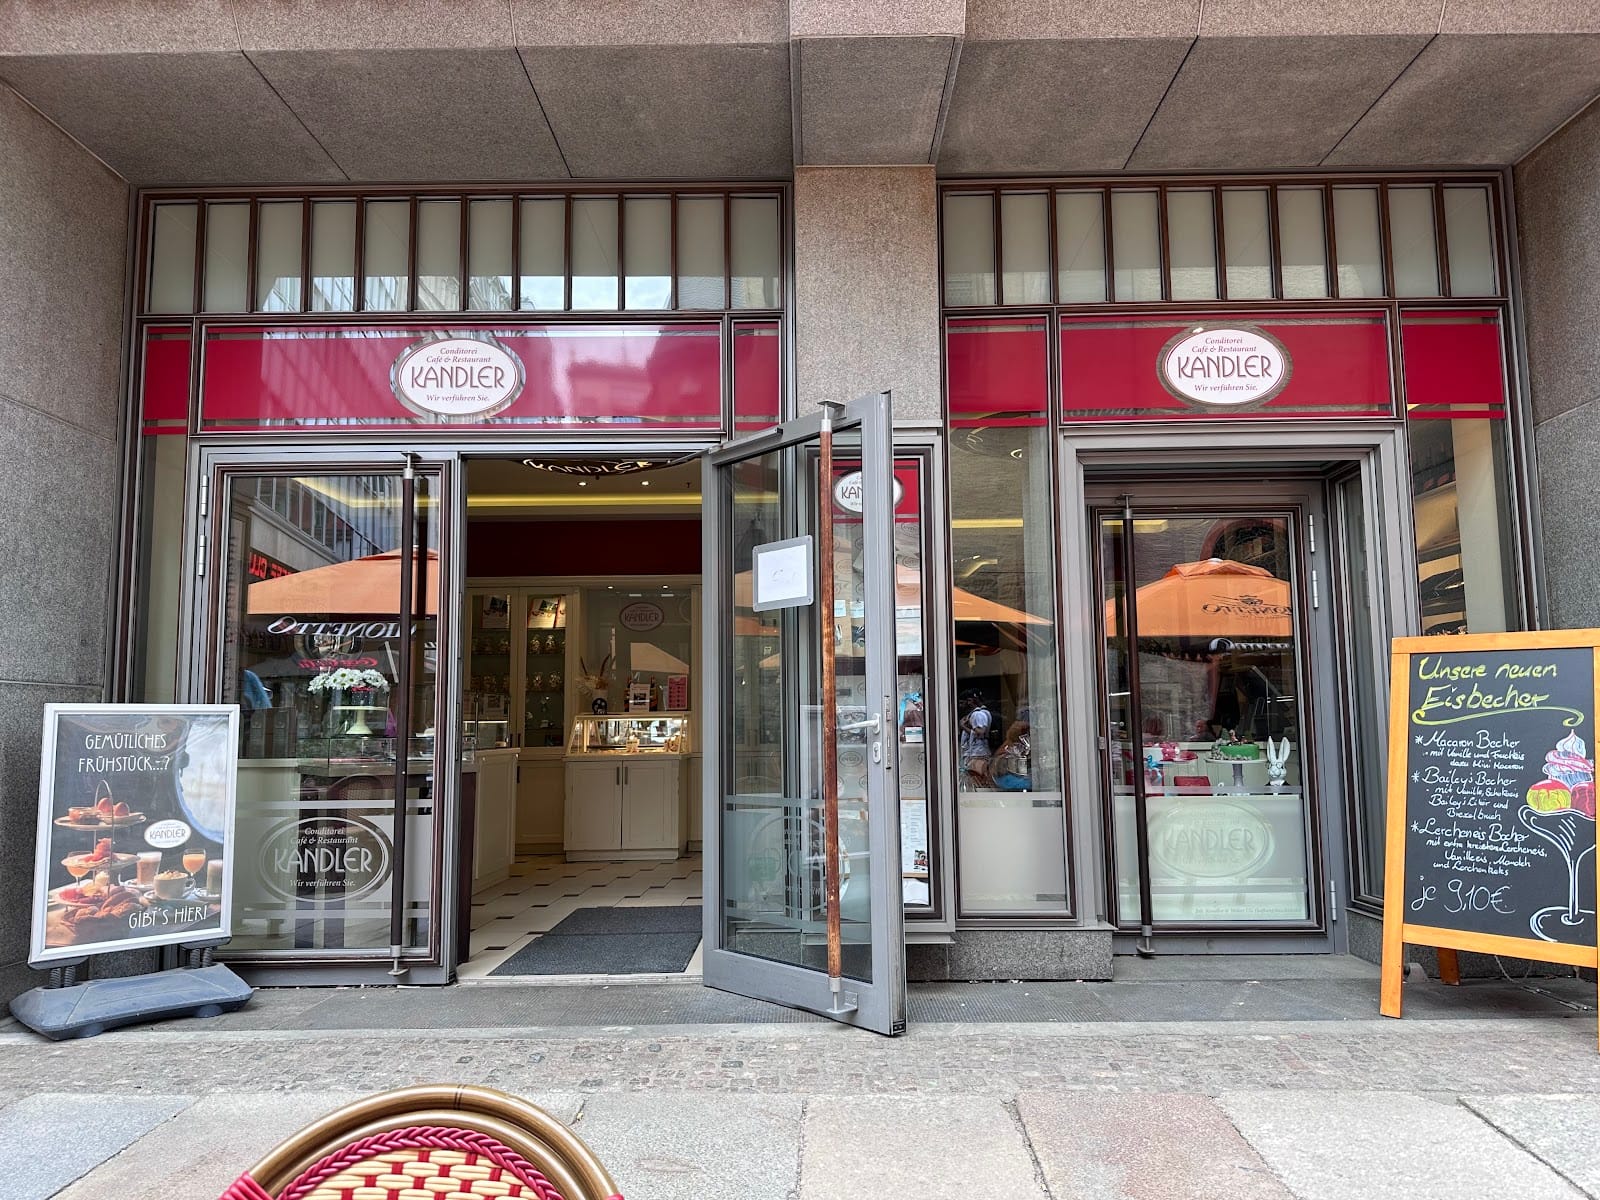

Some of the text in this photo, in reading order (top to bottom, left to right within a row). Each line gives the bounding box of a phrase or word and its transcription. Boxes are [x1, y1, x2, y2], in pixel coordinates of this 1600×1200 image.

[1205, 337, 1243, 345] Conditorei
[440, 347, 478, 355] Conditorei
[1191, 345, 1209, 354] Café
[1218, 345, 1257, 353] Restaurant
[426, 355, 443, 363] Café
[452, 355, 492, 363] Restaurant
[1177, 355, 1273, 379] KANDLER
[411, 365, 505, 389] KANDLER
[1194, 384, 1208, 392] Wir
[1210, 384, 1244, 392] verführen
[426, 394, 440, 402] Wir
[441, 394, 476, 403] verführen
[1418, 656, 1557, 680] Unsere neuen
[1420, 683, 1550, 710] Eisbecher
[85, 733, 166, 749] GEMÜTLICHES
[1423, 729, 1520, 749] Macaron Becher
[1475, 771, 1517, 786] Becher
[1435, 784, 1453, 794] mit
[1493, 800, 1509, 809] und
[150, 829, 186, 840] KANDLER
[304, 827, 345, 835] Conditorei
[1419, 818, 1529, 842] Lercheneis Becher
[317, 836, 358, 844] Restaurant
[1426, 836, 1441, 846] mit
[274, 847, 372, 873] KANDLER
[1411, 875, 1436, 911] je
